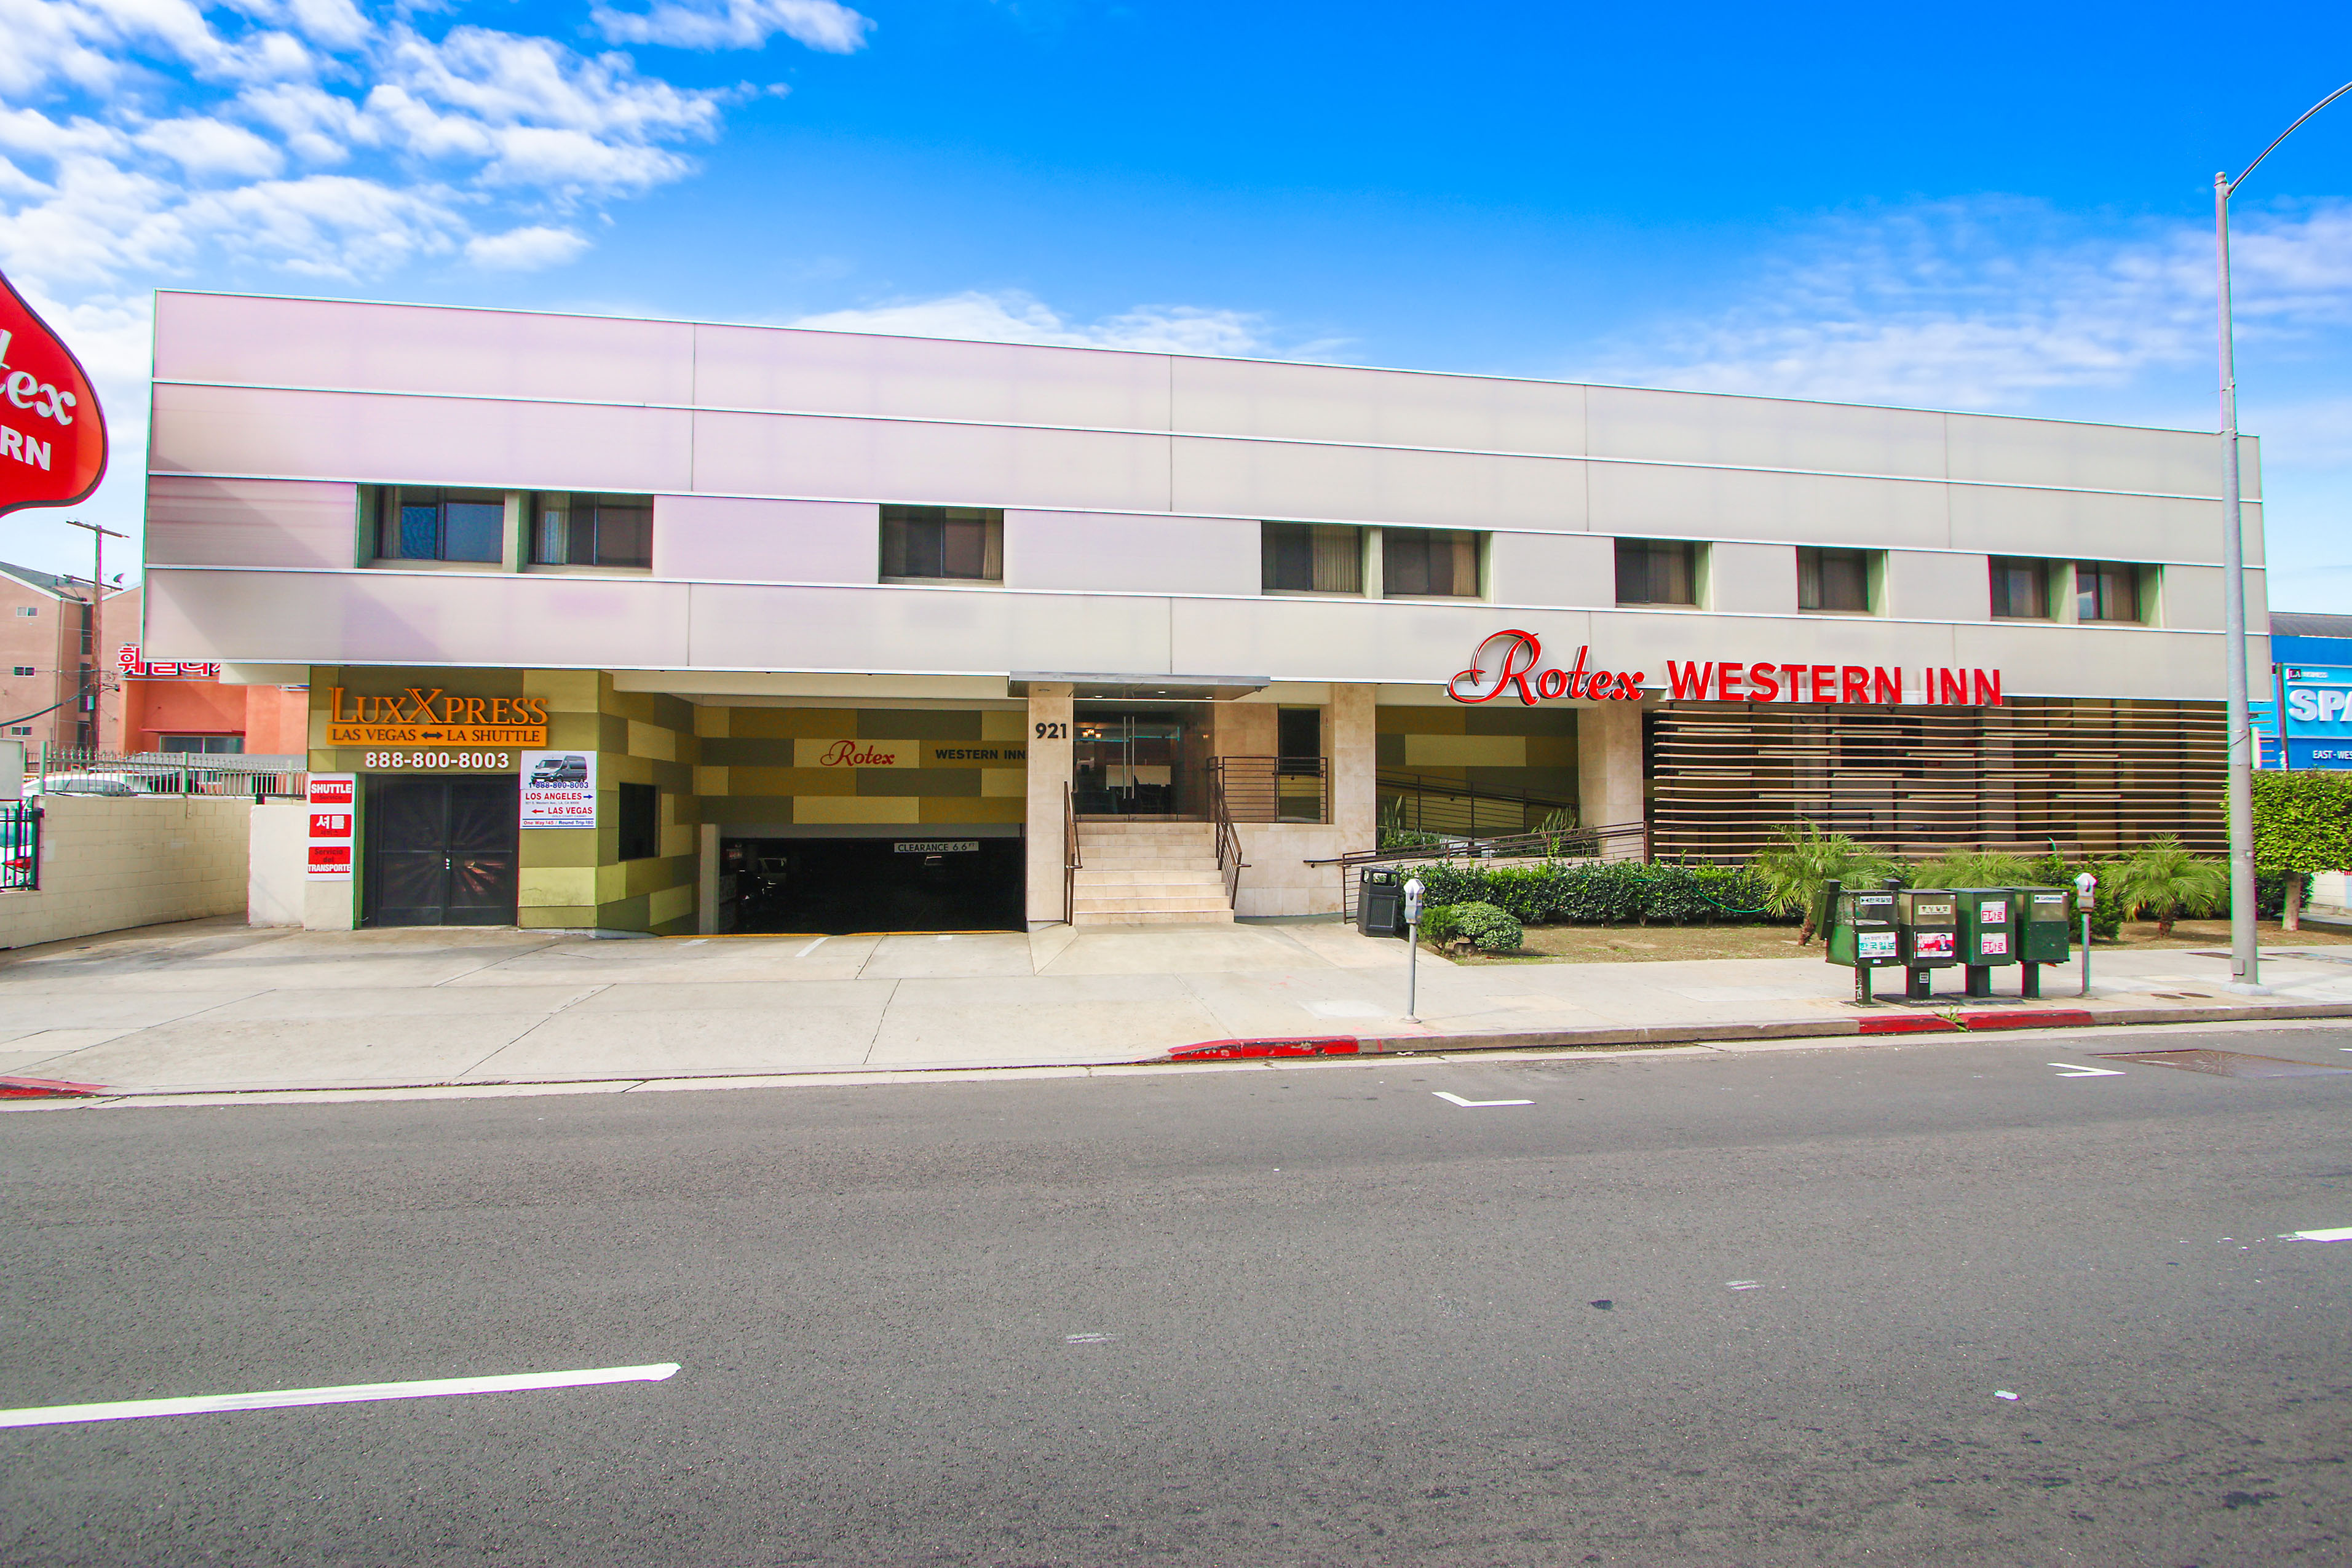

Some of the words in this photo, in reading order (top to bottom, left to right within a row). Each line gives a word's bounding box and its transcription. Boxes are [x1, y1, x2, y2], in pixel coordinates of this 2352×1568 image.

[0, 425, 51, 472] RN
[1447, 629, 1645, 705] Rotex
[1665, 660, 1903, 705] WESTERN
[1923, 667, 2002, 706] INN
[333, 729, 360, 741] LAS
[368, 729, 416, 741] VEGAS
[447, 729, 467, 742] LA
[472, 729, 540, 742] SHUTTLE
[1035, 723, 1067, 739] 921
[365, 751, 509, 769] 888-800-8003
[820, 740, 895, 766] Rotex
[935, 749, 998, 759] WESTERN
[1004, 750, 1026, 759] INN
[311, 784, 352, 794] SHUTTLE
[898, 843, 948, 852] CLEARANCE
[1859, 941, 1895, 951] 한국일보
